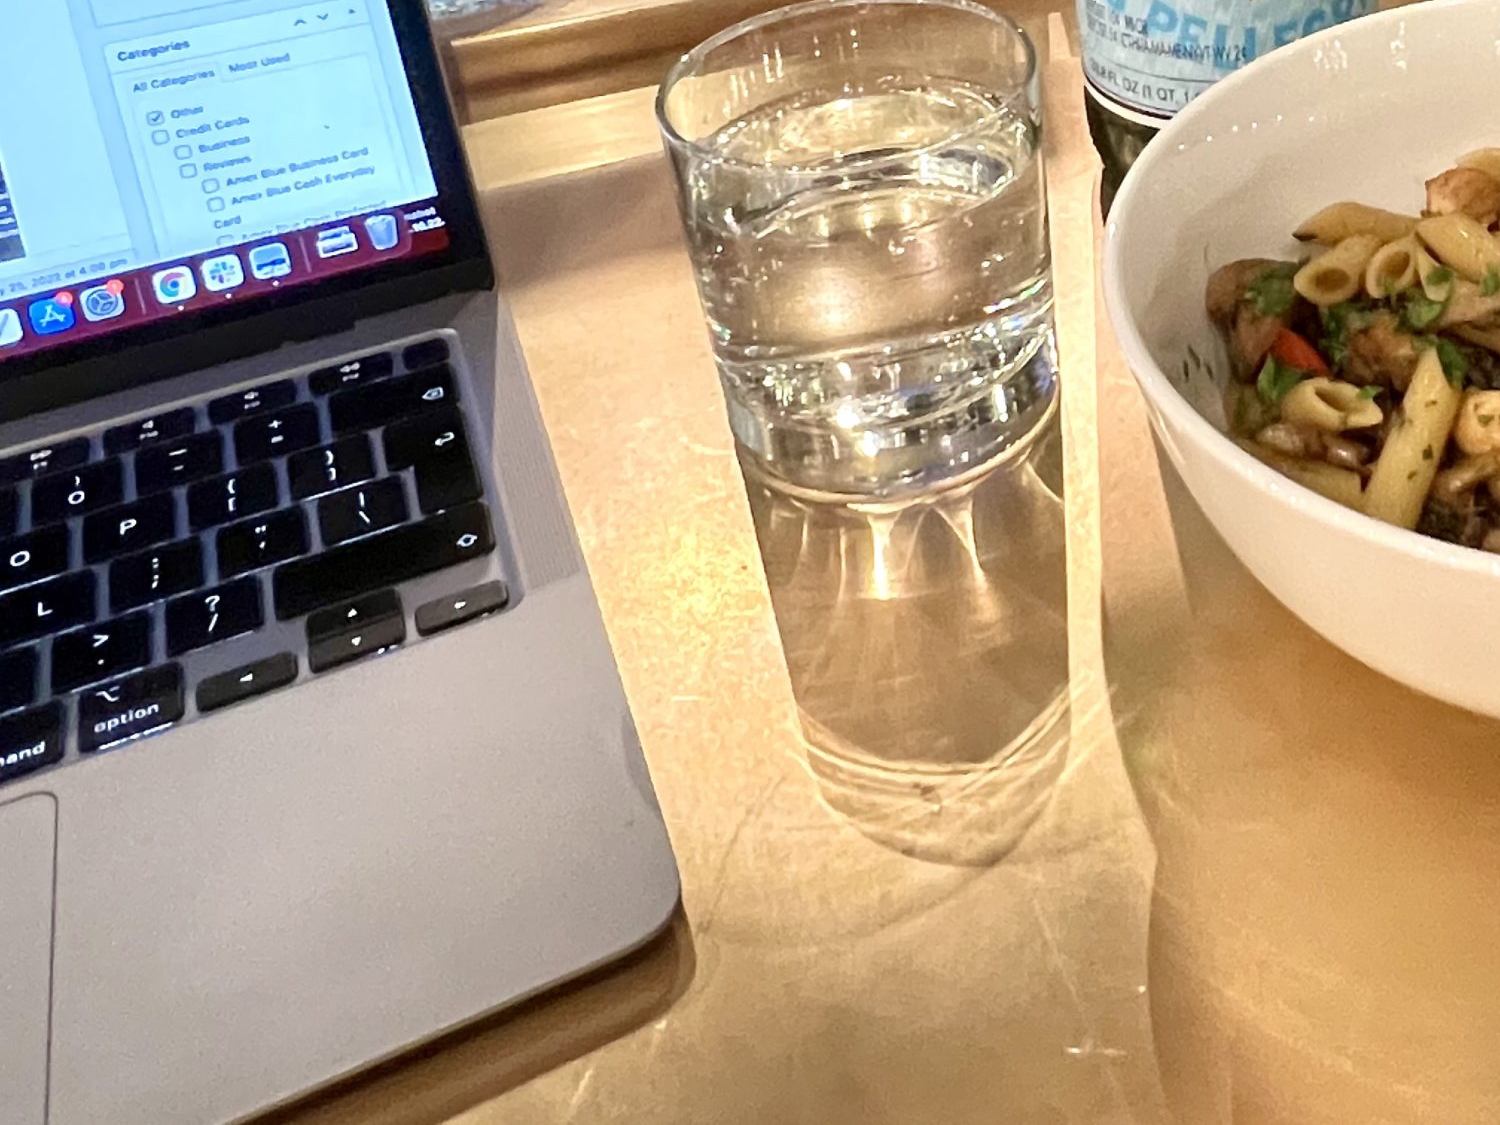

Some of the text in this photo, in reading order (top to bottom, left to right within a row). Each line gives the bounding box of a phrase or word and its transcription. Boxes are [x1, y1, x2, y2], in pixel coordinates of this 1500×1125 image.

[117, 39, 190, 62] Categories
[119, 518, 137, 536] P
[37, 601, 53, 617] L
[93, 703, 160, 734] option
